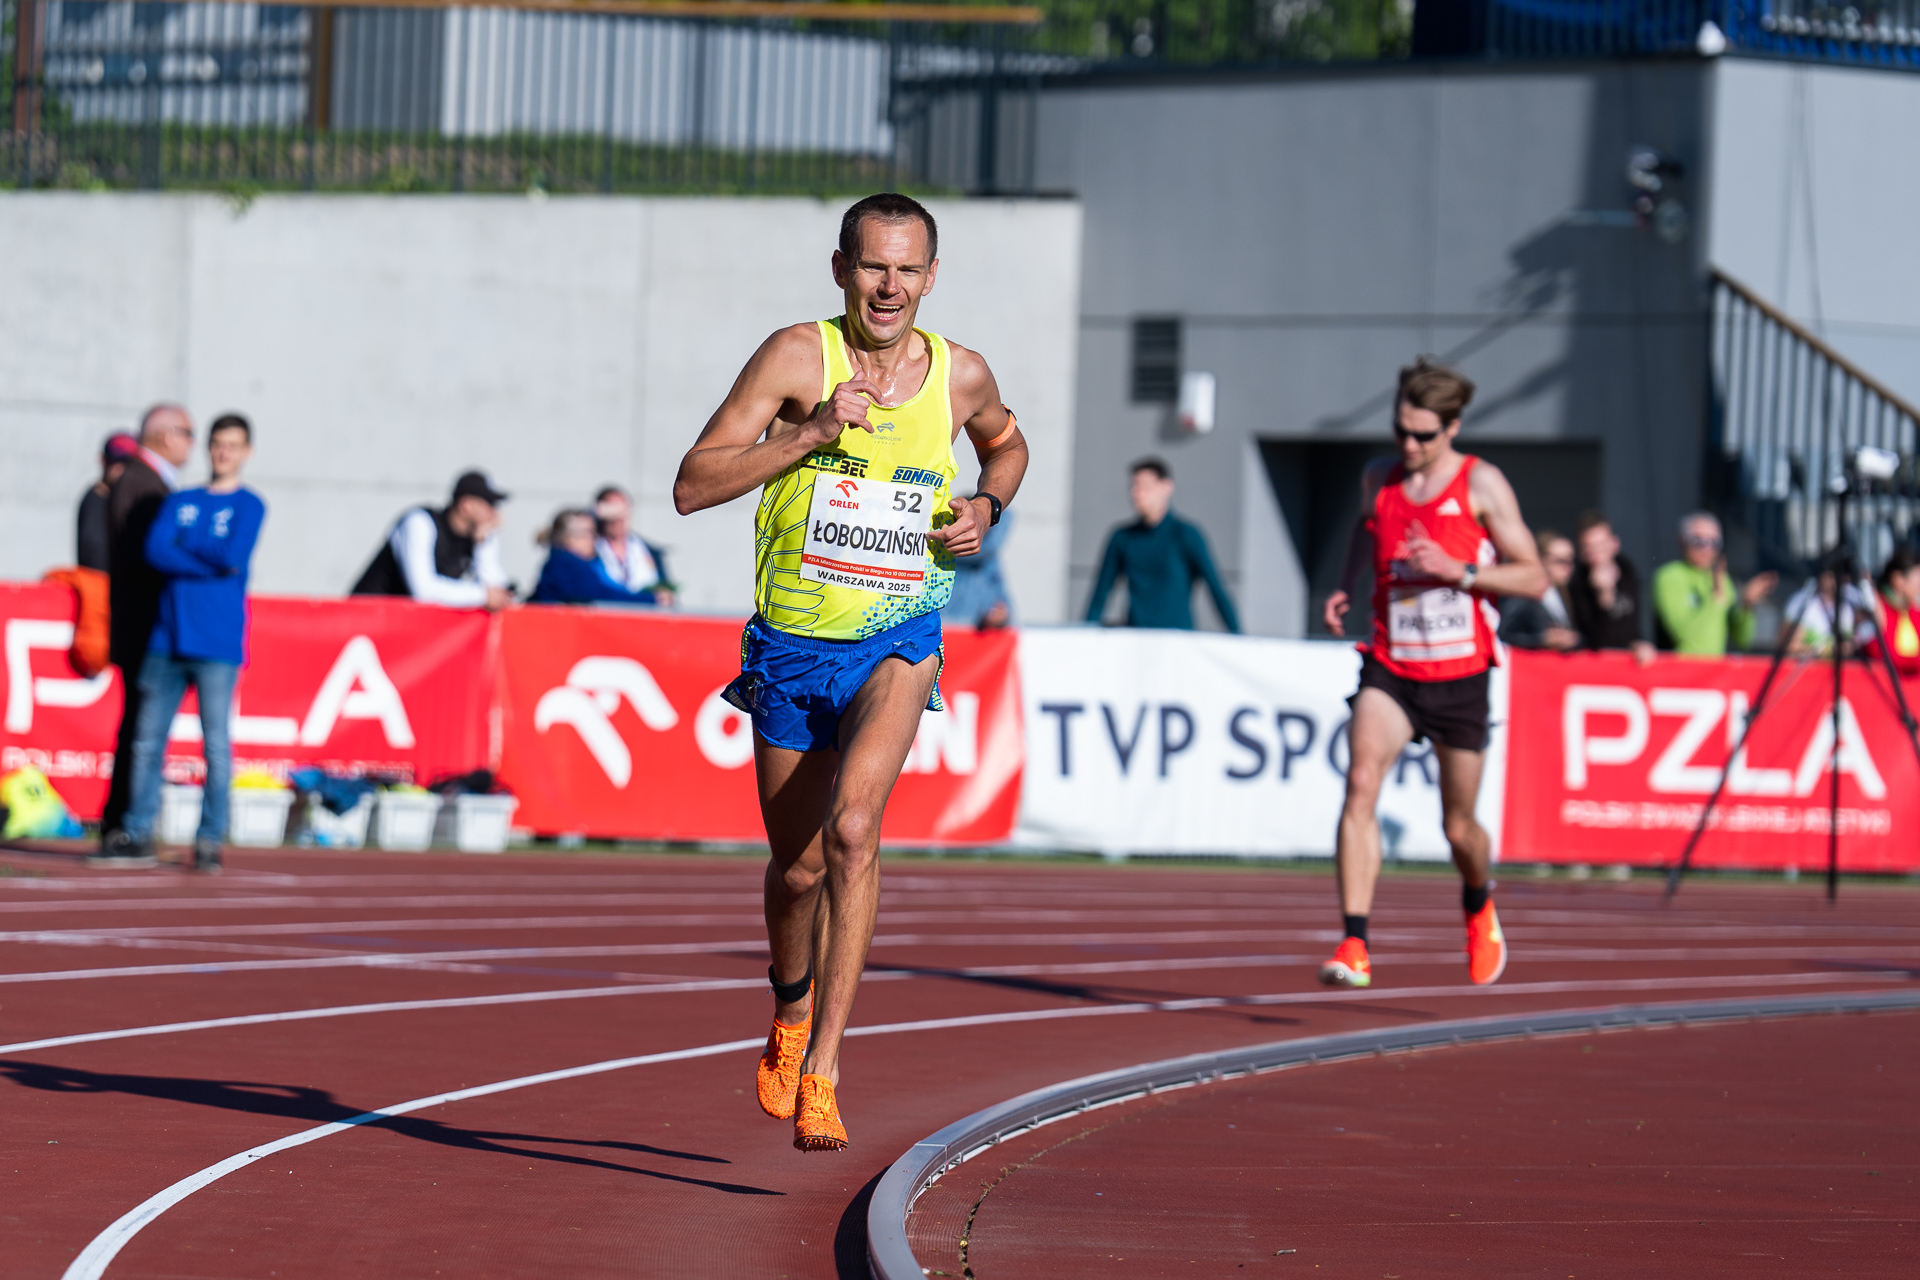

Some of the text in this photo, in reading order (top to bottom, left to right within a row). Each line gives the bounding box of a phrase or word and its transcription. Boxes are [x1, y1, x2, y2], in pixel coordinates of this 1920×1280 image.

[829, 498, 860, 510] ORLEN
[892, 490, 923, 514] 52
[812, 519, 926, 556] ŁOBODZIŃSKI
[816, 569, 911, 592] WARSZAWA 2025
[5, 618, 416, 748] PA
[694, 682, 980, 774] OEN
[1039, 702, 1197, 778] TVP
[1563, 683, 1888, 801] PZLA
